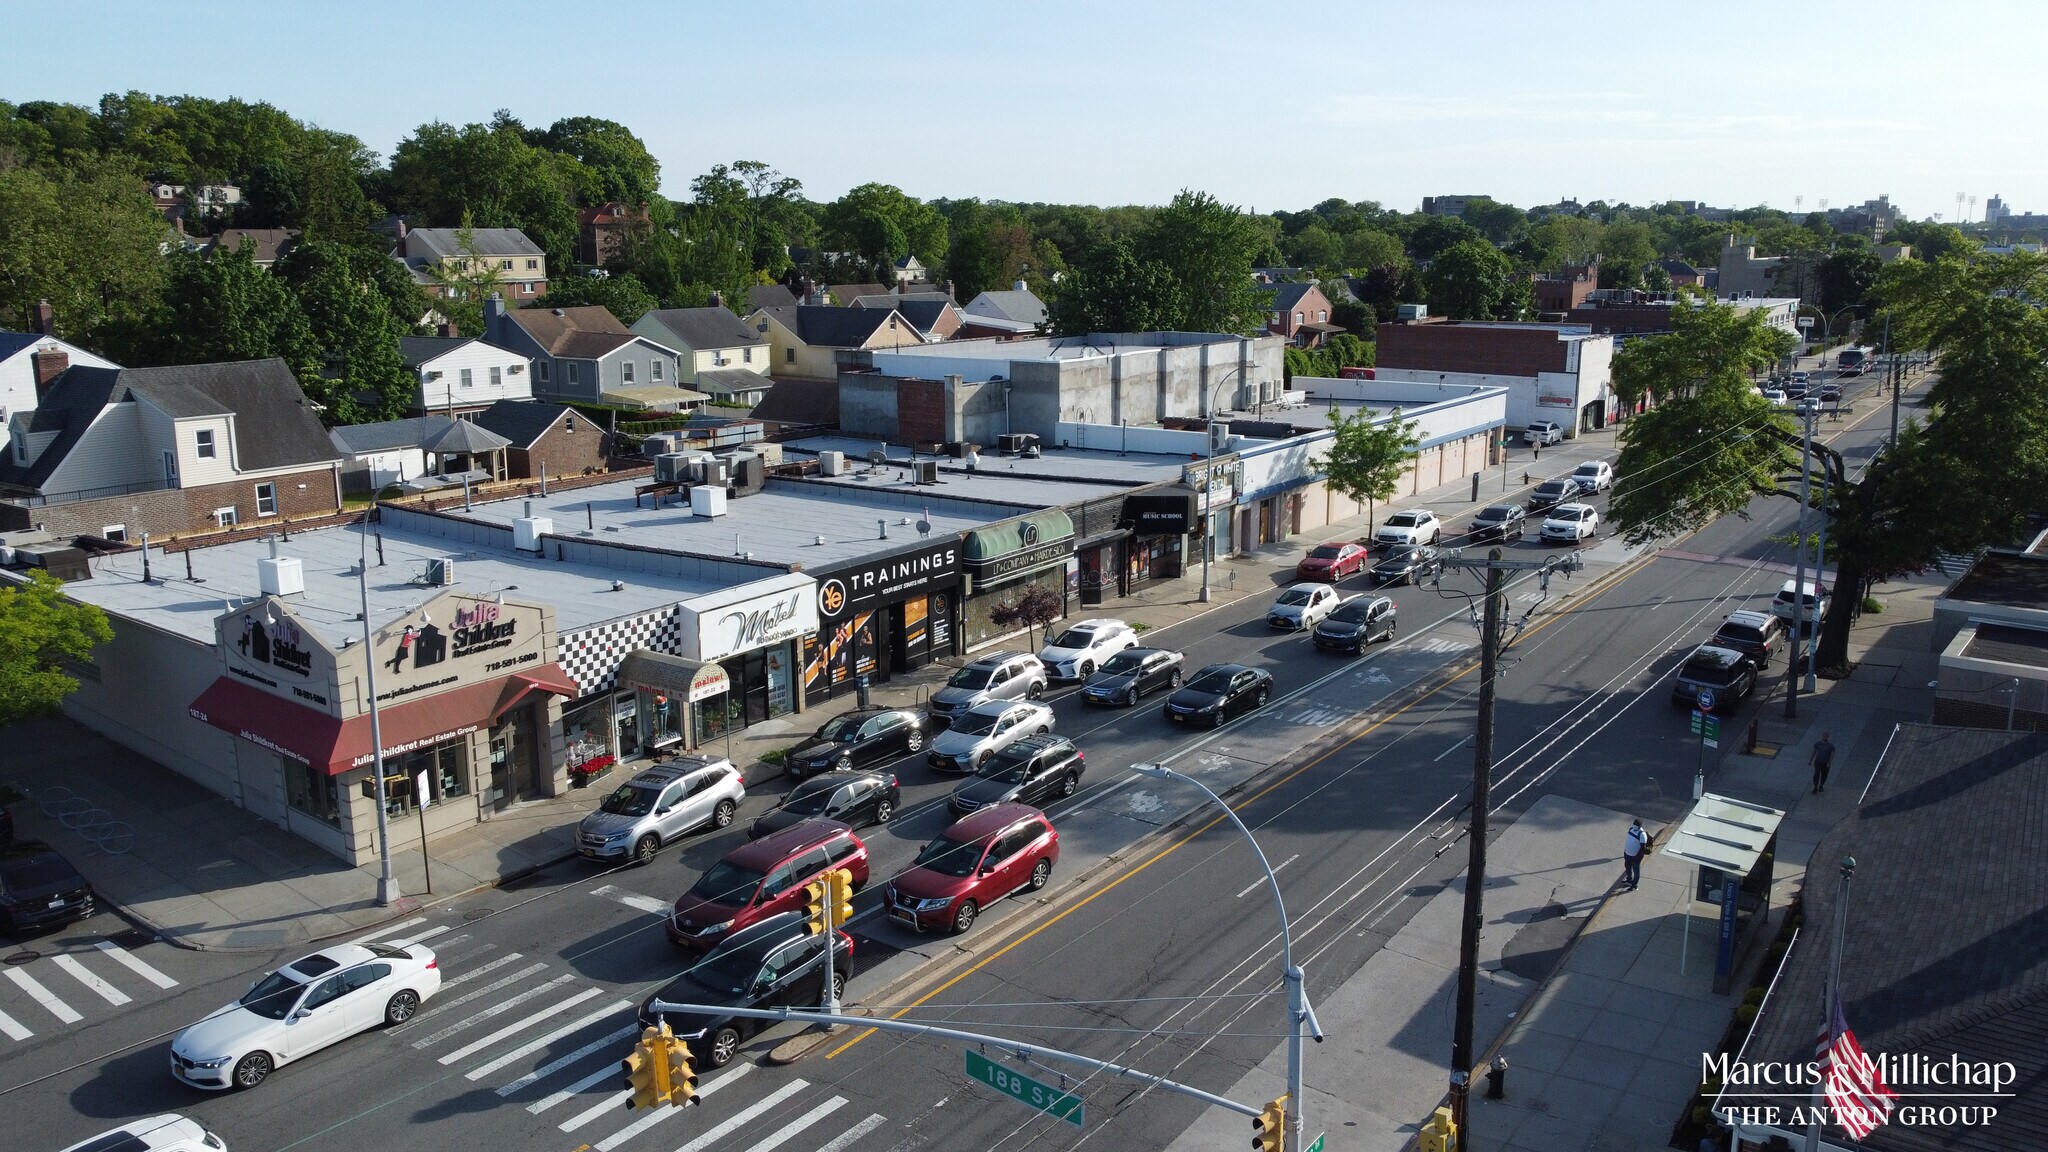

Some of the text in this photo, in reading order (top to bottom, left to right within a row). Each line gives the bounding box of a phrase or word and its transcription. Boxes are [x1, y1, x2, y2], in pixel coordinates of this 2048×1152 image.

[1195, 467, 1215, 481] BRIGT
[851, 549, 955, 590] TRAININGS
[451, 603, 499, 629] Julia
[452, 618, 516, 649] Shildkret
[485, 652, 538, 672] 718-591-5000
[189, 708, 208, 722] 187-24
[240, 729, 252, 741] Julia
[352, 755, 375, 767] Julia
[419, 736, 434, 747] Real
[435, 731, 456, 742] Estate
[457, 724, 478, 735] Group
[988, 1065, 1055, 1110] 188 St
